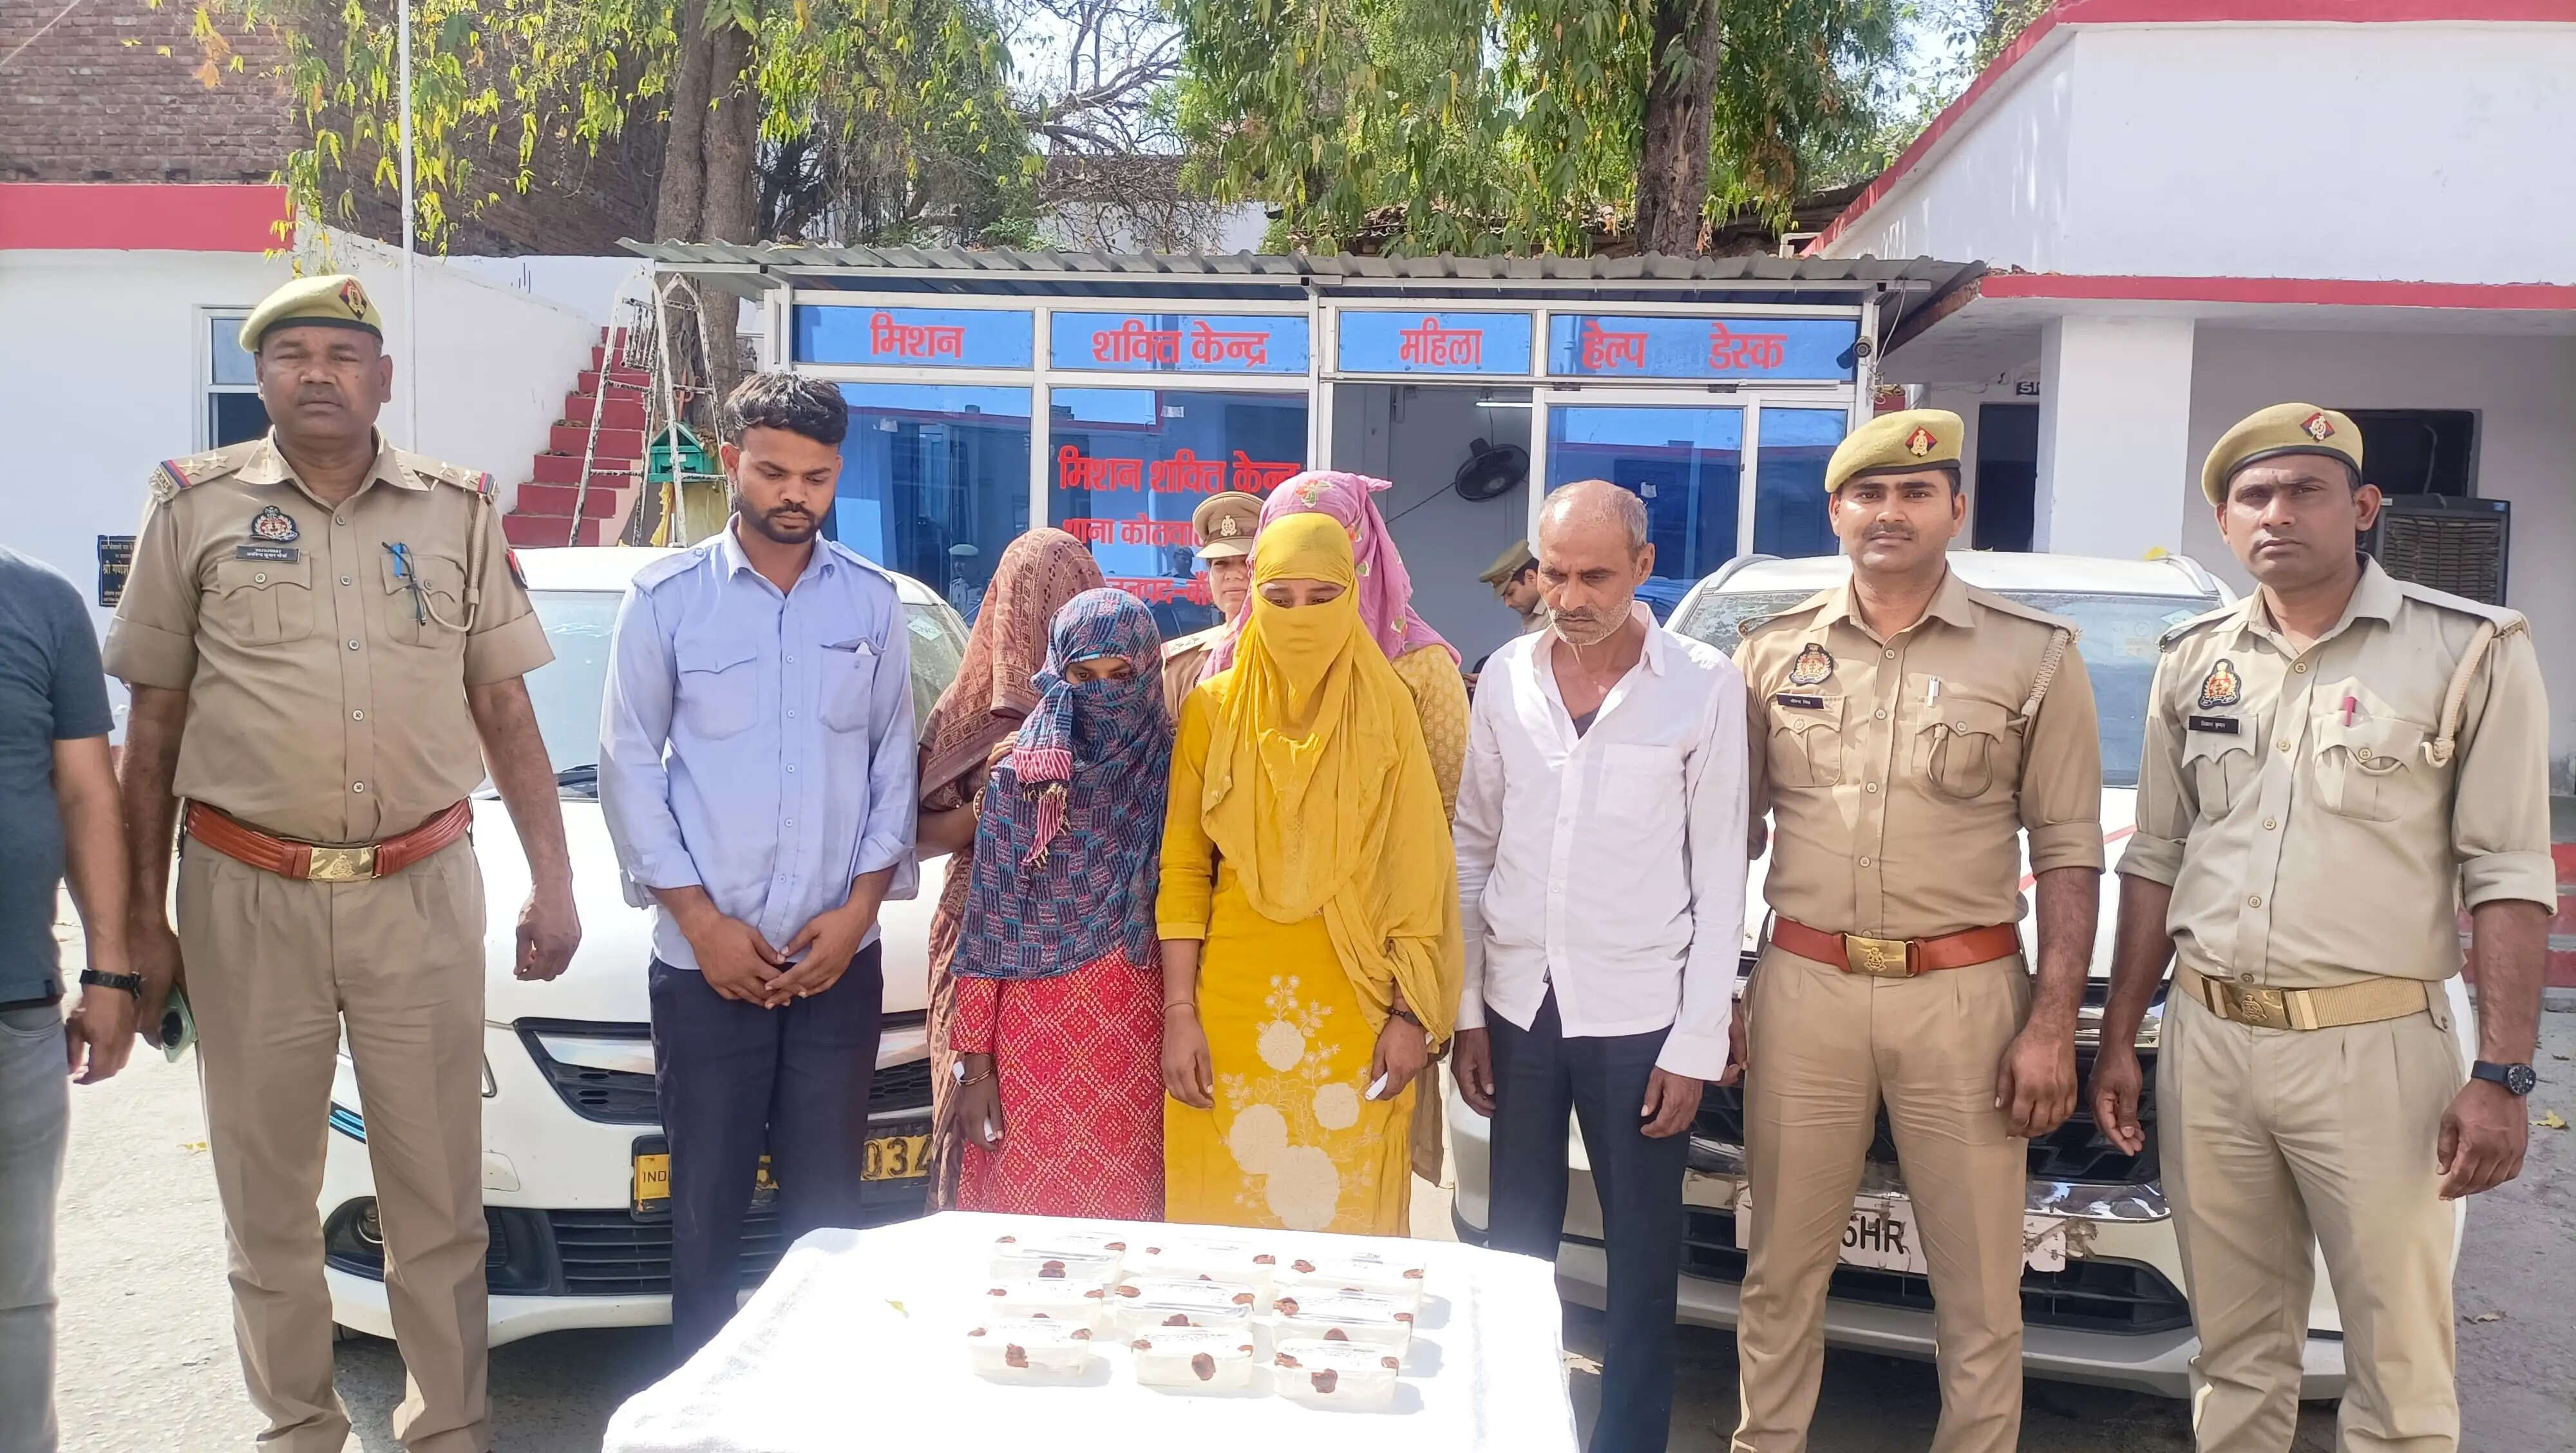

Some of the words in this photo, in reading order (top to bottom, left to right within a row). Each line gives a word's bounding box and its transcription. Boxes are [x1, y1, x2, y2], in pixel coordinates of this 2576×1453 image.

[869, 312, 965, 359] मिशन
[1092, 319, 1182, 363] शक्ति
[1190, 321, 1269, 368] केन्द्र
[1399, 317, 1482, 366] महिला
[1582, 321, 1647, 369] हेल्प
[1709, 323, 1787, 370] डेस्क
[1058, 445, 1143, 492] मिशन
[1149, 449, 1226, 493] शक्ति
[643, 1170, 667, 1182] IND
